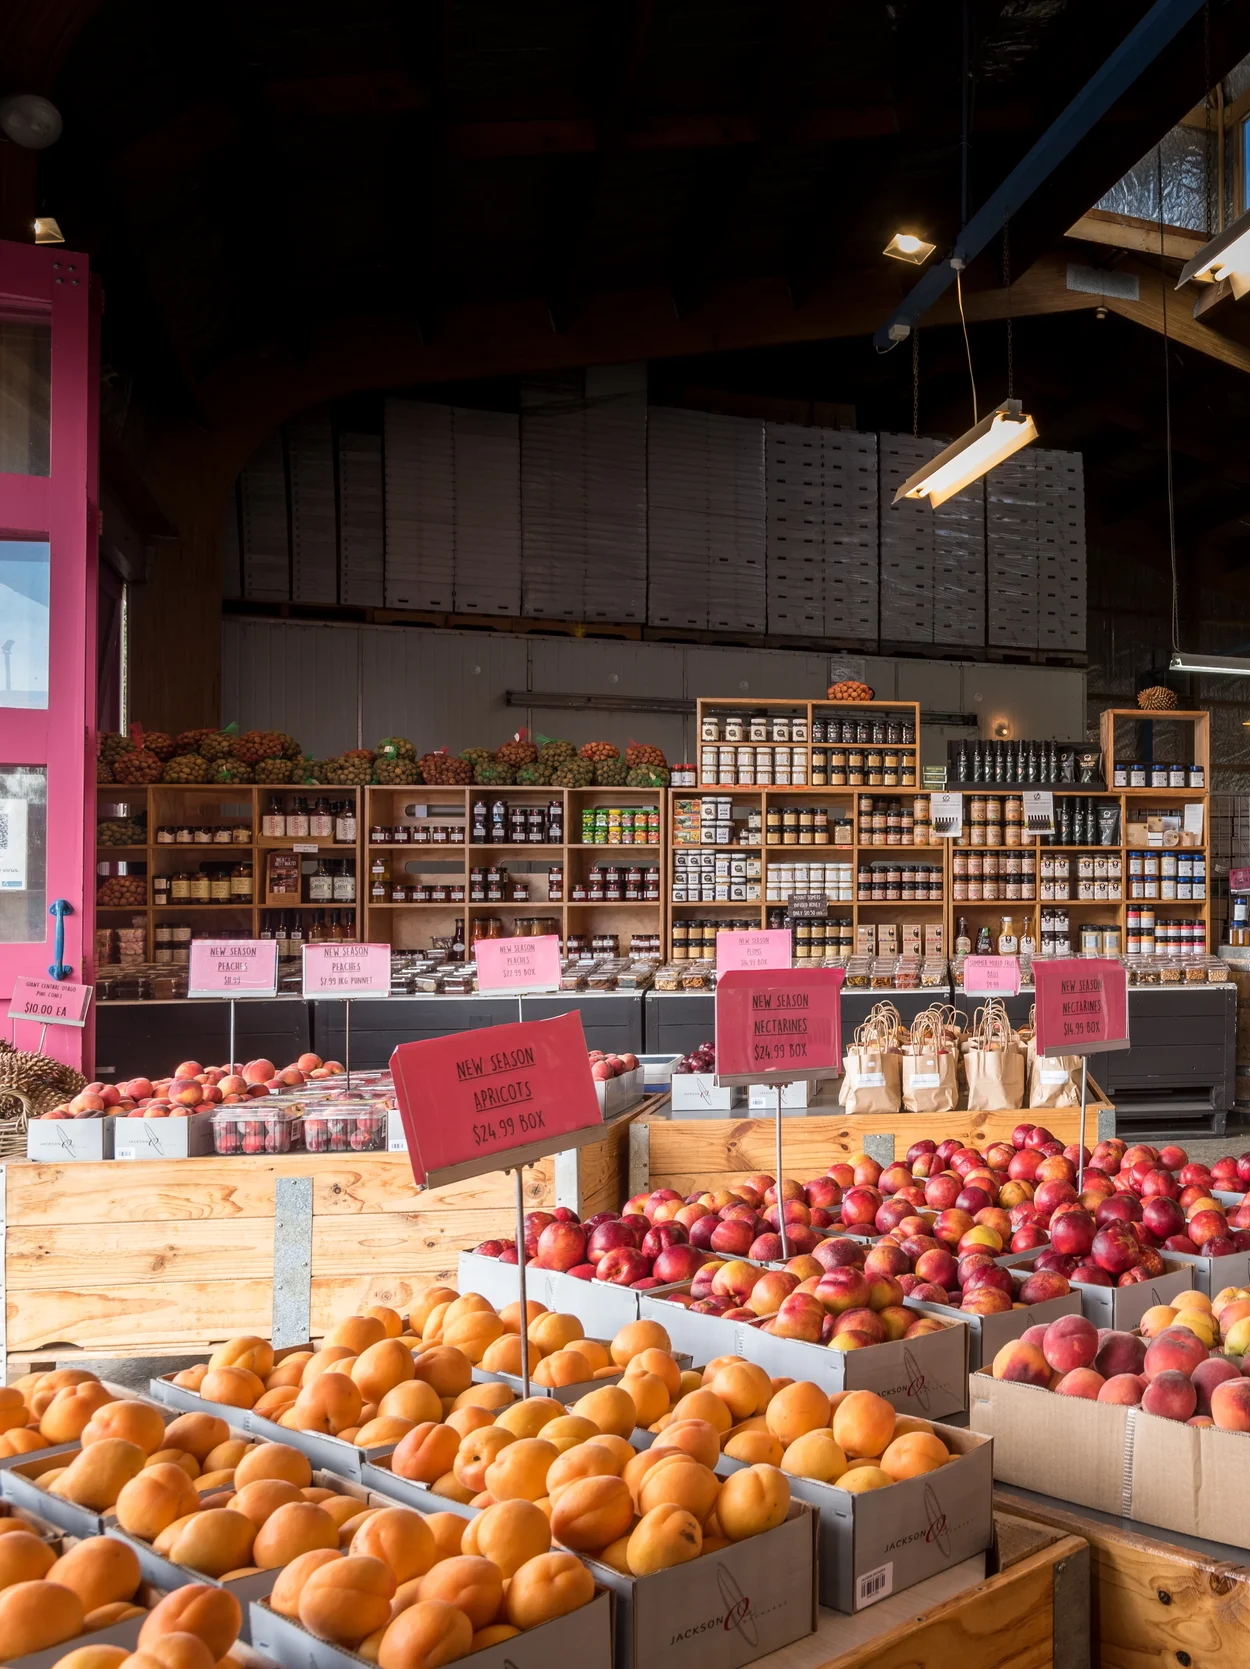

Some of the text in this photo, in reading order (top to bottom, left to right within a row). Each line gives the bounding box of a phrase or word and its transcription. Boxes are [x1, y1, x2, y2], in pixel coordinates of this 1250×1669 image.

[210, 946, 256, 956] NEW SEASON
[324, 946, 369, 957] NEW SEASON
[500, 944, 536, 953] NEW SEASON
[747, 948, 762, 956] PLUMS
[218, 962, 248, 972] PEACHES
[332, 962, 361, 972] PEACHES
[507, 956, 530, 965] PEACHES
[523, 968, 536, 976] BOX
[320, 977, 337, 986] $7.99
[350, 976, 373, 985] PUNNET
[1061, 980, 1102, 992] NEW SEASON
[752, 994, 809, 1009] NEW SEASON
[1063, 1000, 1101, 1015] NECTARINES
[24, 1002, 67, 1016] $10.00 EA
[754, 1018, 808, 1034] NECTARINES
[1063, 1022, 1100, 1037] $14.99 BOX
[754, 1043, 808, 1062] $24.99 BOX
[456, 1047, 535, 1079] NEW SEASON
[474, 1081, 532, 1110] APRICOTS
[473, 1110, 546, 1146] $24.99 BOX
[876, 1385, 907, 1398] ACKSON
[884, 1529, 926, 1553] JACKSON
[670, 1616, 724, 1646] JACKSON
